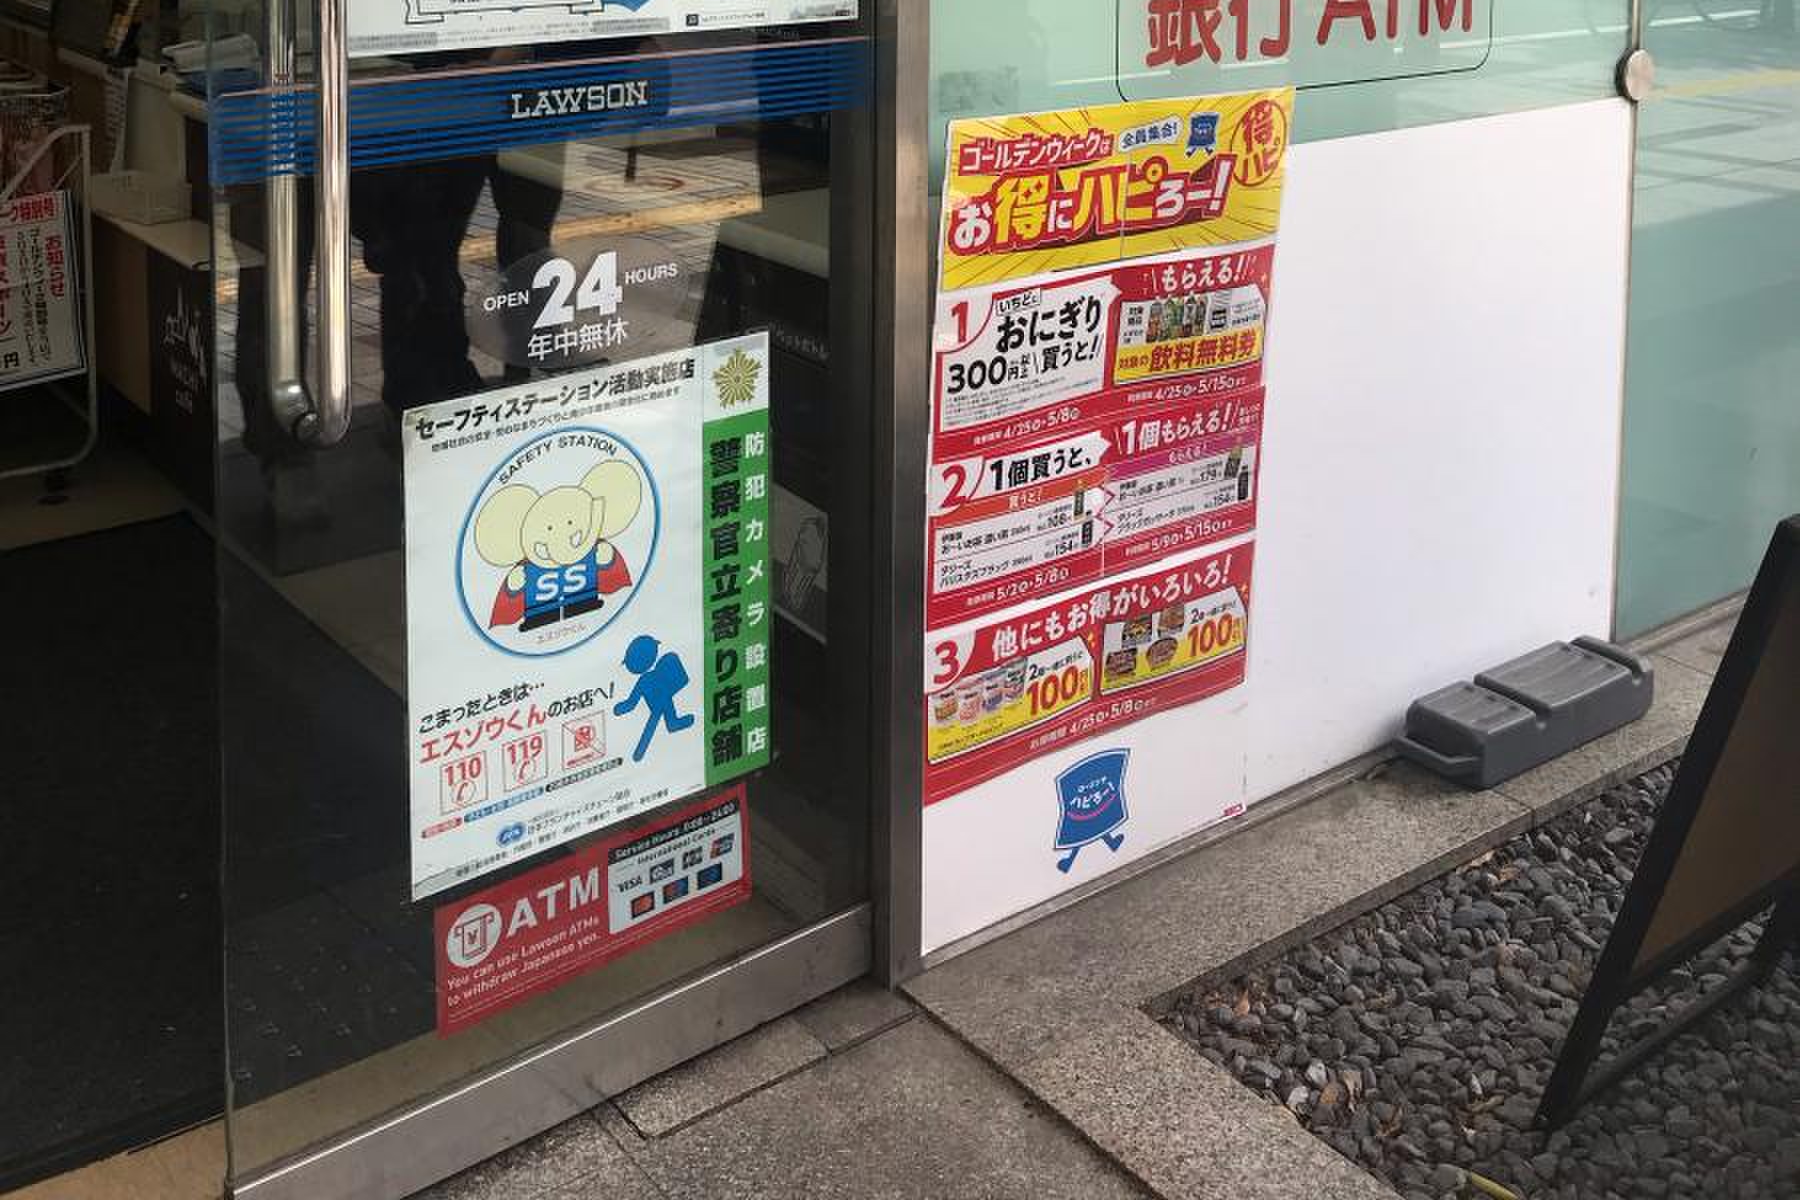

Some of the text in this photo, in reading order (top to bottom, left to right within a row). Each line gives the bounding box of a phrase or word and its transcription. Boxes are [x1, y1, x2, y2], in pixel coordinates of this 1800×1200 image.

[512, 80, 648, 121] LAWSON
[483, 252, 678, 329] OPEN 24 HOURS
[528, 318, 629, 361] 年中無休
[951, 301, 968, 343] 1
[996, 295, 1101, 353] おにぎり
[499, 435, 618, 485] SAFETY STATION
[941, 465, 966, 508] 2
[535, 566, 587, 601] SS
[934, 640, 960, 684] 3
[506, 735, 544, 763] 119
[444, 757, 482, 787] 110
[506, 866, 599, 938] ATM
[448, 916, 599, 990] You can use Lawson ATMs
[463, 968, 518, 999] withdraw
[521, 943, 575, 974] Japanese
